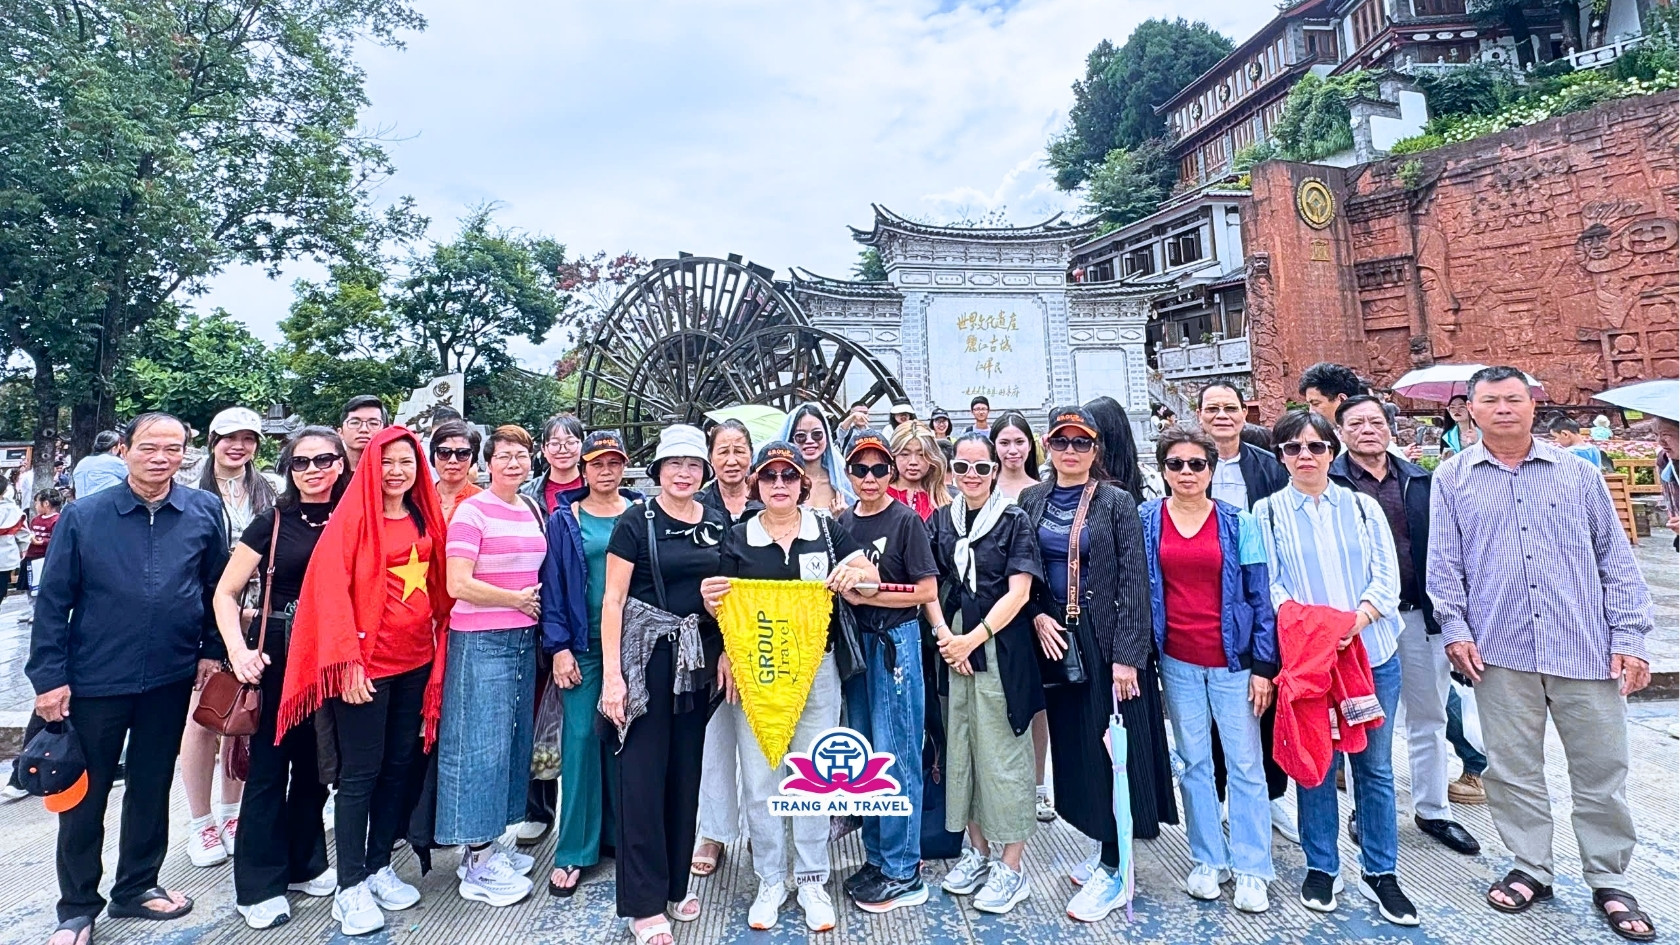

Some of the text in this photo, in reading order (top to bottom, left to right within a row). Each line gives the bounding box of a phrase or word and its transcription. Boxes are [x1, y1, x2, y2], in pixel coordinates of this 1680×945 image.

[811, 562, 821, 570] M
[757, 610, 775, 684] GROUP
[776, 619, 790, 679] Travel
